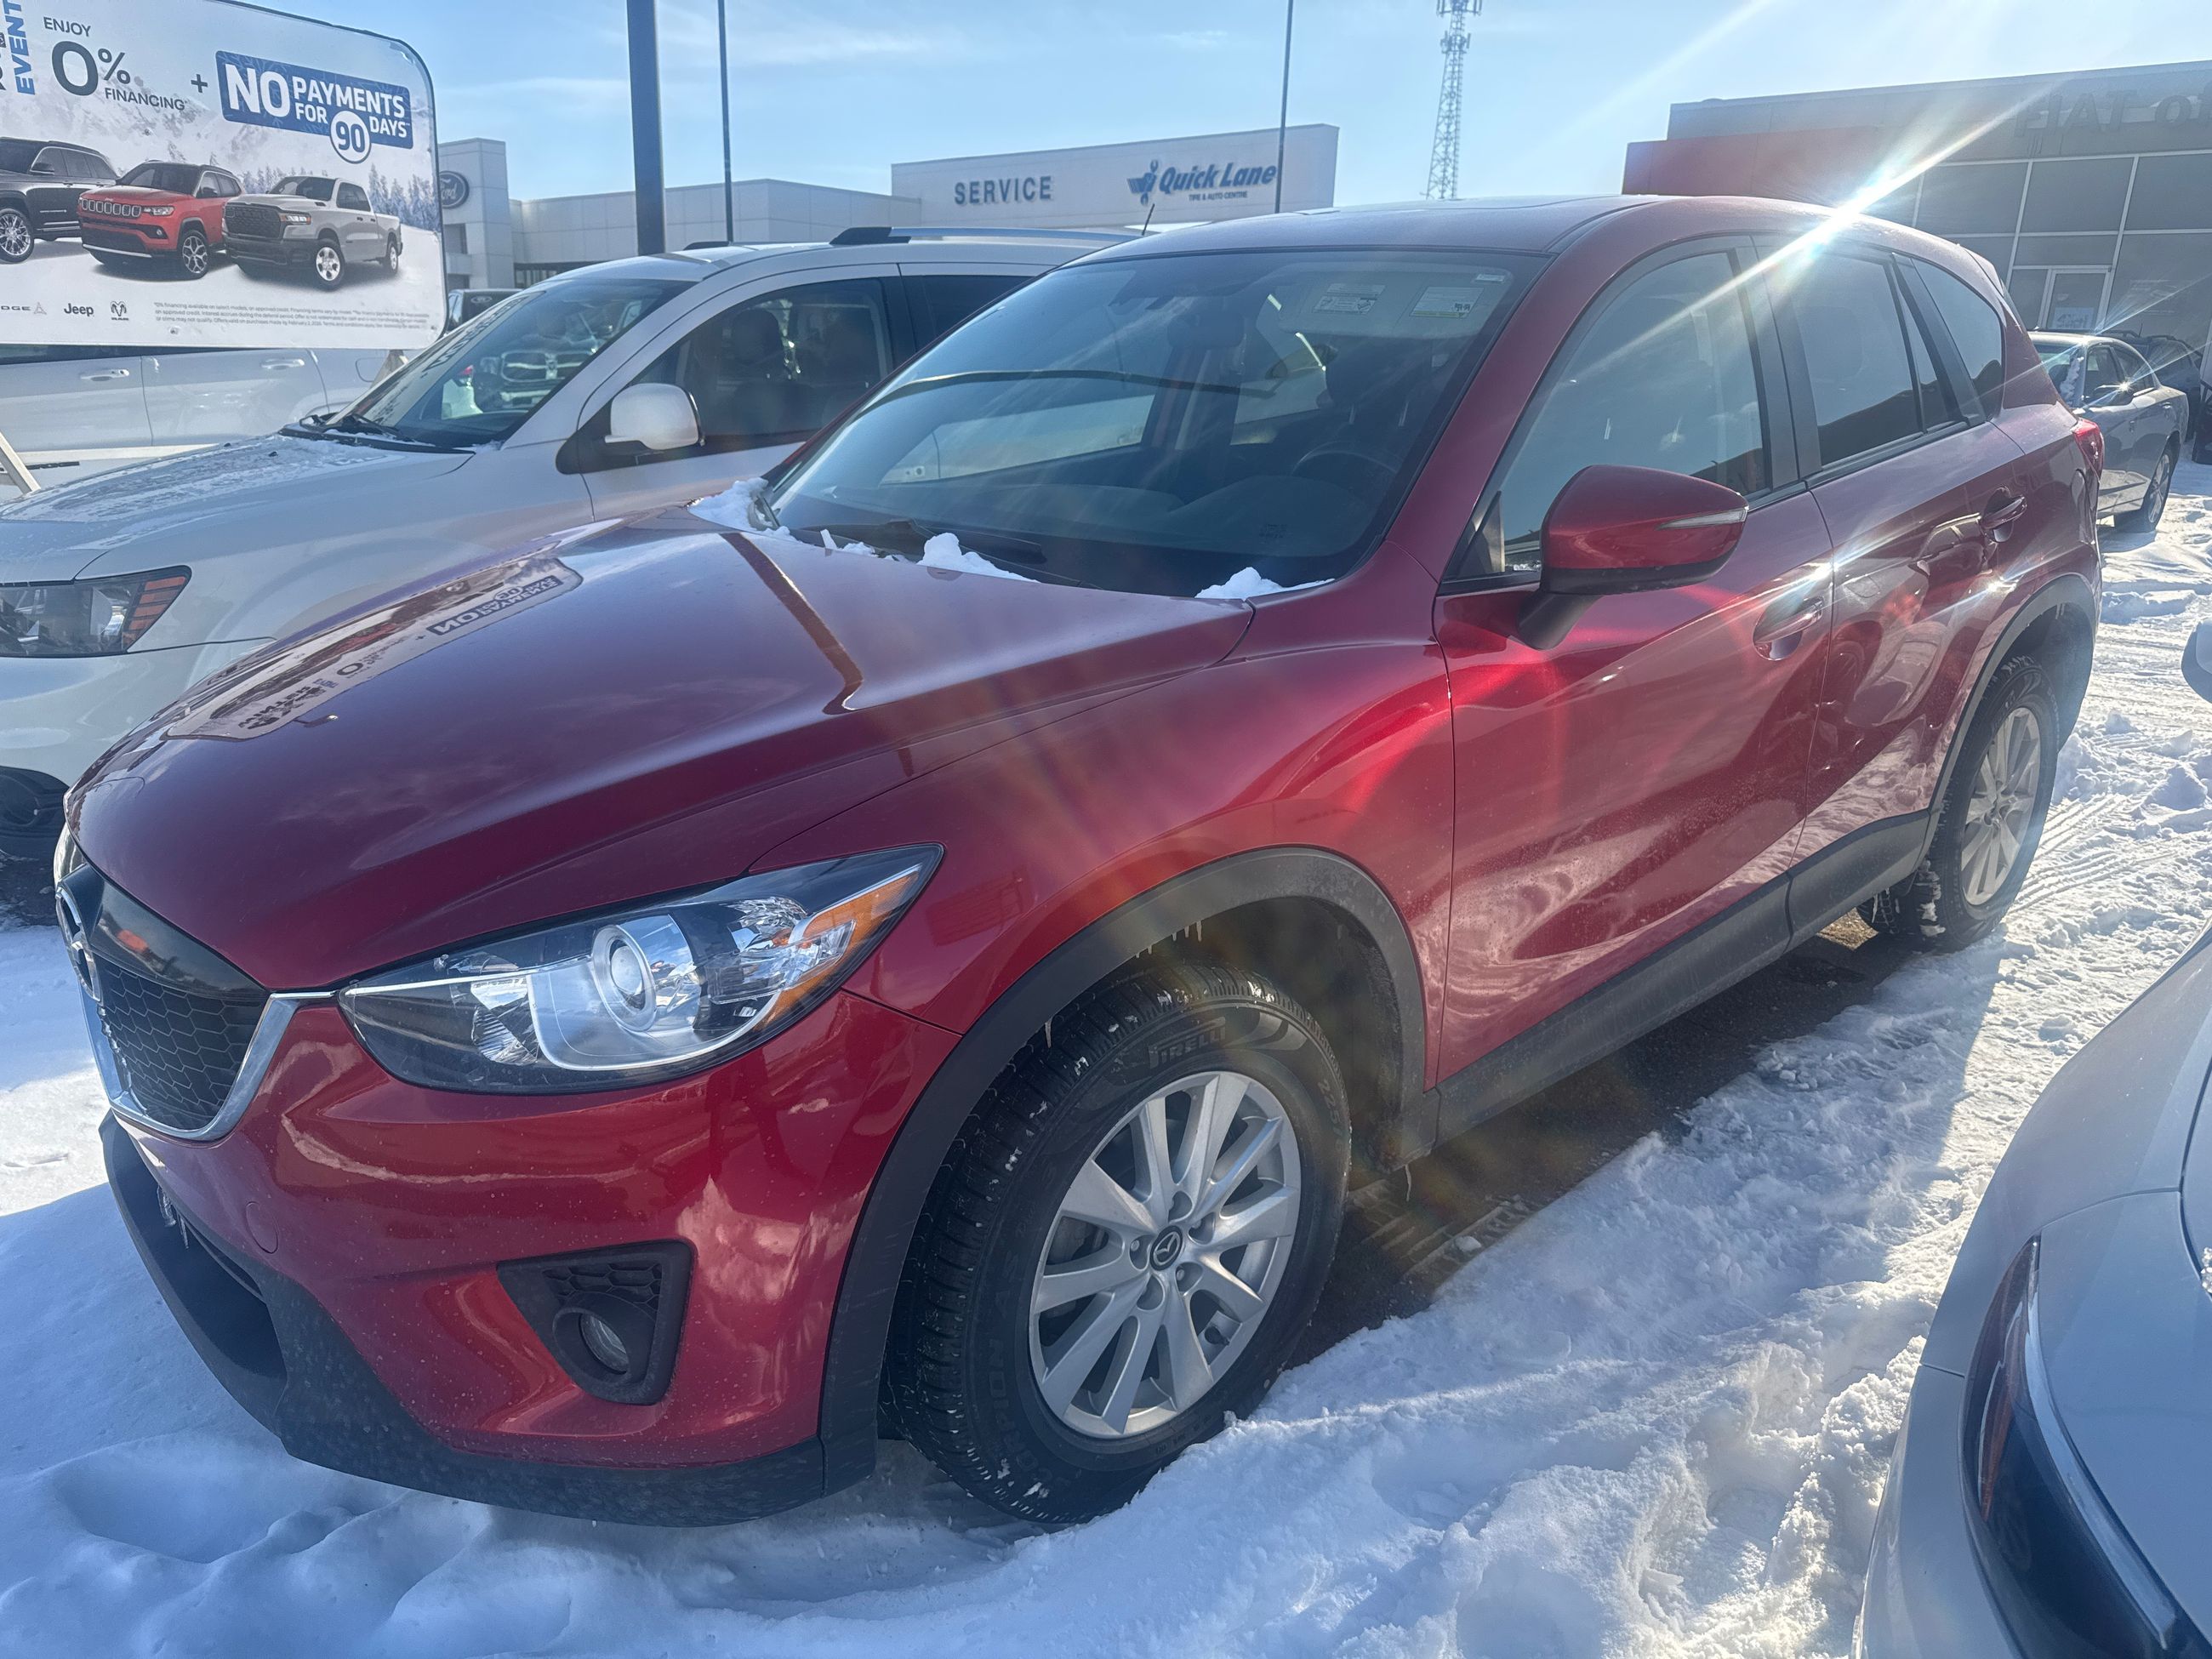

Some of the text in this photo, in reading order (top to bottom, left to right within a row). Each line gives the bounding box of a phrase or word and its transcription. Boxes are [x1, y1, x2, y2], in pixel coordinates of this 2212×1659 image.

[43, 16, 91, 37] ENJOY
[3, 0, 35, 95] EVENT
[52, 41, 131, 96] 0%
[225, 63, 291, 117] NO
[293, 76, 406, 118] PAYMENTS
[295, 102, 328, 124] FOR
[335, 121, 366, 152] 90
[954, 175, 1053, 206] SERVICE
[1159, 162, 1277, 195] Quick Lane
[64, 303, 94, 316] Jeep
